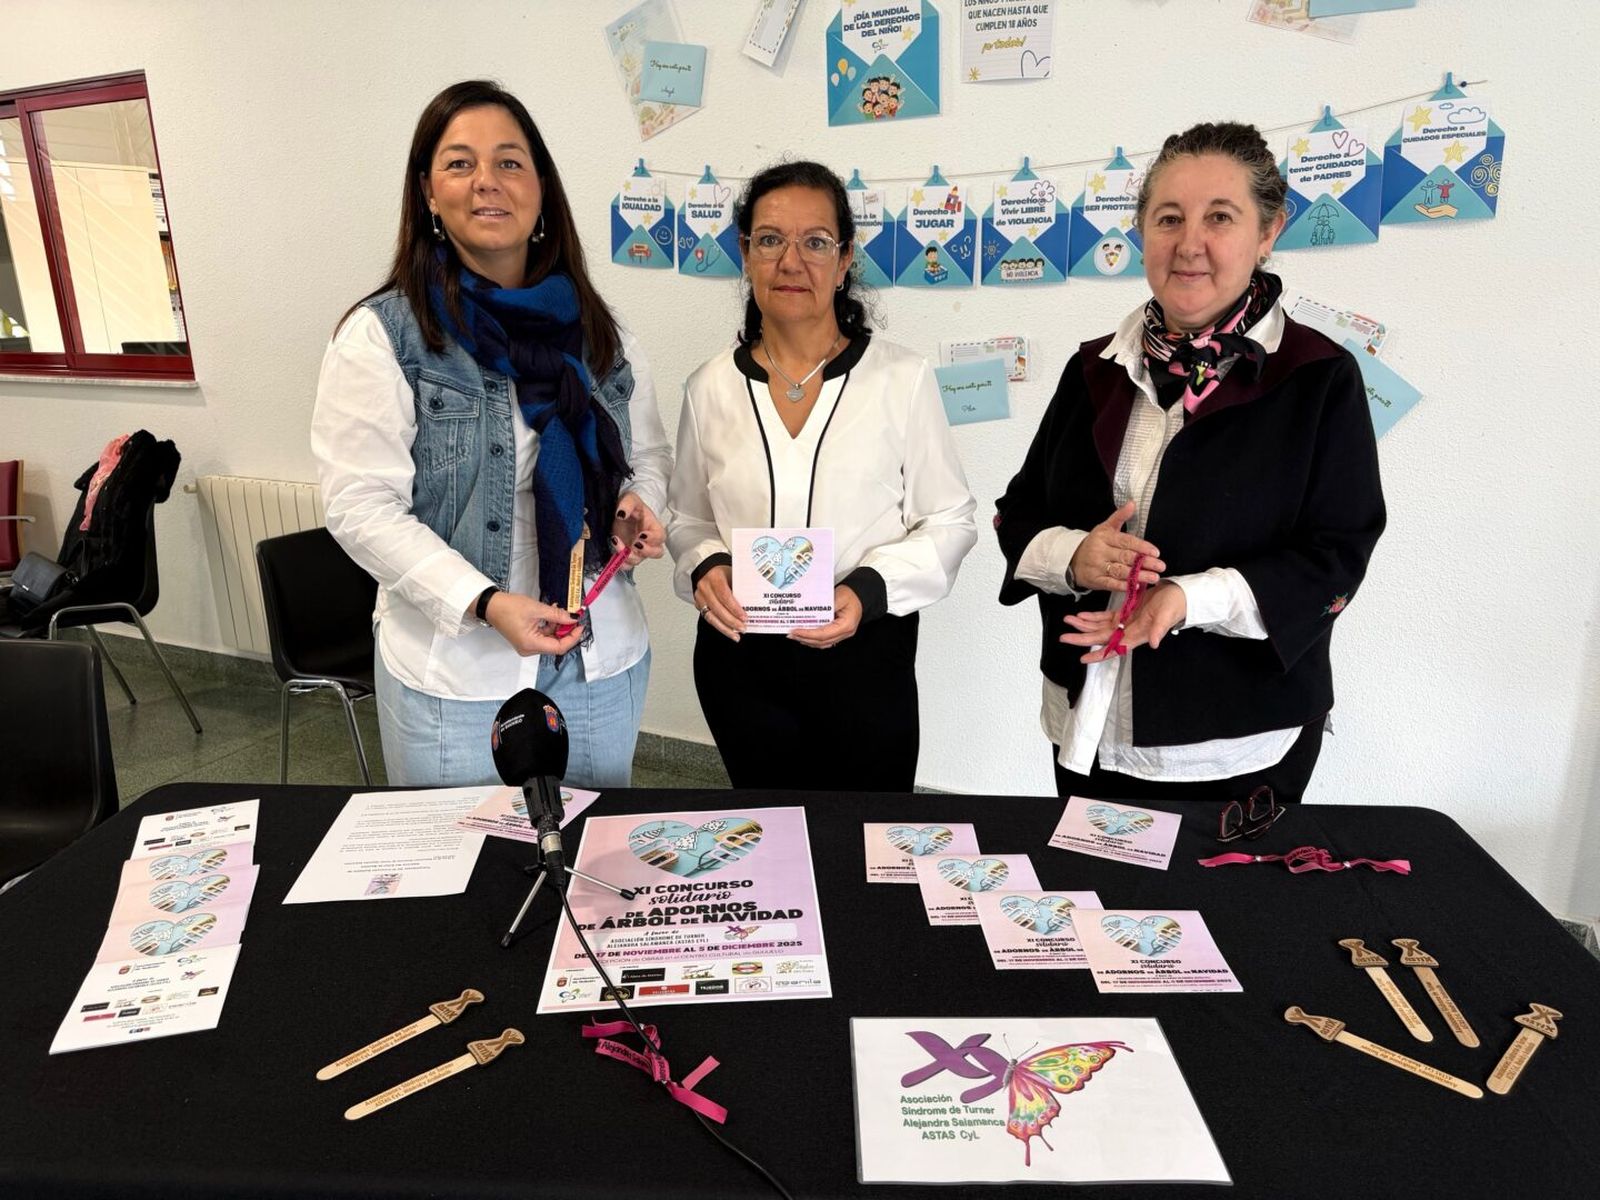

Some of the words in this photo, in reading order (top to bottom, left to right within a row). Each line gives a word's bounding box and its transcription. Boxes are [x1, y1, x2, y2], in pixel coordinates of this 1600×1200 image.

[853, 10, 870, 23] ¡DÍA
[871, 6, 910, 18] MUNDIAL
[968, 10, 981, 19] QUE
[982, 8, 1006, 18] NACEN
[1007, 6, 1031, 15] HASTA
[1033, 5, 1048, 14] QUE
[843, 24, 855, 32] DE
[856, 21, 873, 30] LOS
[874, 13, 920, 27] DERECHOS
[975, 21, 1007, 32] CUMPLEN
[1008, 19, 1015, 28] 18
[1017, 17, 1037, 28] AÑOS
[861, 30, 877, 38] DEL
[878, 24, 902, 35] NIÑO!
[1422, 125, 1458, 134] Derecho
[1402, 135, 1440, 144] CUIDADOS
[1441, 131, 1487, 140] ESPECIALES
[1300, 152, 1342, 163] Derecho
[1289, 166, 1314, 174] tener
[1315, 158, 1365, 170] CUIDADOS
[1300, 175, 1312, 183] de
[1313, 170, 1352, 181] PADRES
[1001, 197, 1038, 206] Derecho
[1095, 195, 1130, 203] Derecho
[622, 202, 662, 212] IGUALDAD
[913, 208, 948, 216] Derecho
[1020, 206, 1046, 214] LIBRE
[691, 210, 722, 219] SALUD
[915, 219, 955, 229] JUGAR
[1007, 216, 1053, 226] VIOLENCIA
[633, 885, 651, 897] XI
[654, 879, 754, 894] CONCURSO
[648, 890, 735, 906] solidario
[625, 911, 644, 919] DE
[648, 901, 758, 917] ADORNOS
[578, 923, 596, 932] DE
[600, 915, 677, 930] ÁRBOL
[680, 917, 699, 925] DE
[702, 908, 803, 924] NAVIDAD
[610, 936, 644, 944] ASOCIACIÓN
[639, 940, 673, 948] SALAMANCA
[622, 947, 682, 957] NOVIEMBRE
[721, 942, 775, 951] DICIEMBRE
[900, 1093, 953, 1104] Asociación
[949, 1105, 961, 1115] de
[962, 1104, 995, 1115] Turner
[902, 1118, 950, 1129] Alejandra
[951, 1117, 1006, 1127] Salamanca
[921, 1131, 956, 1140] ASTAS
[959, 1130, 980, 1142] CyL
